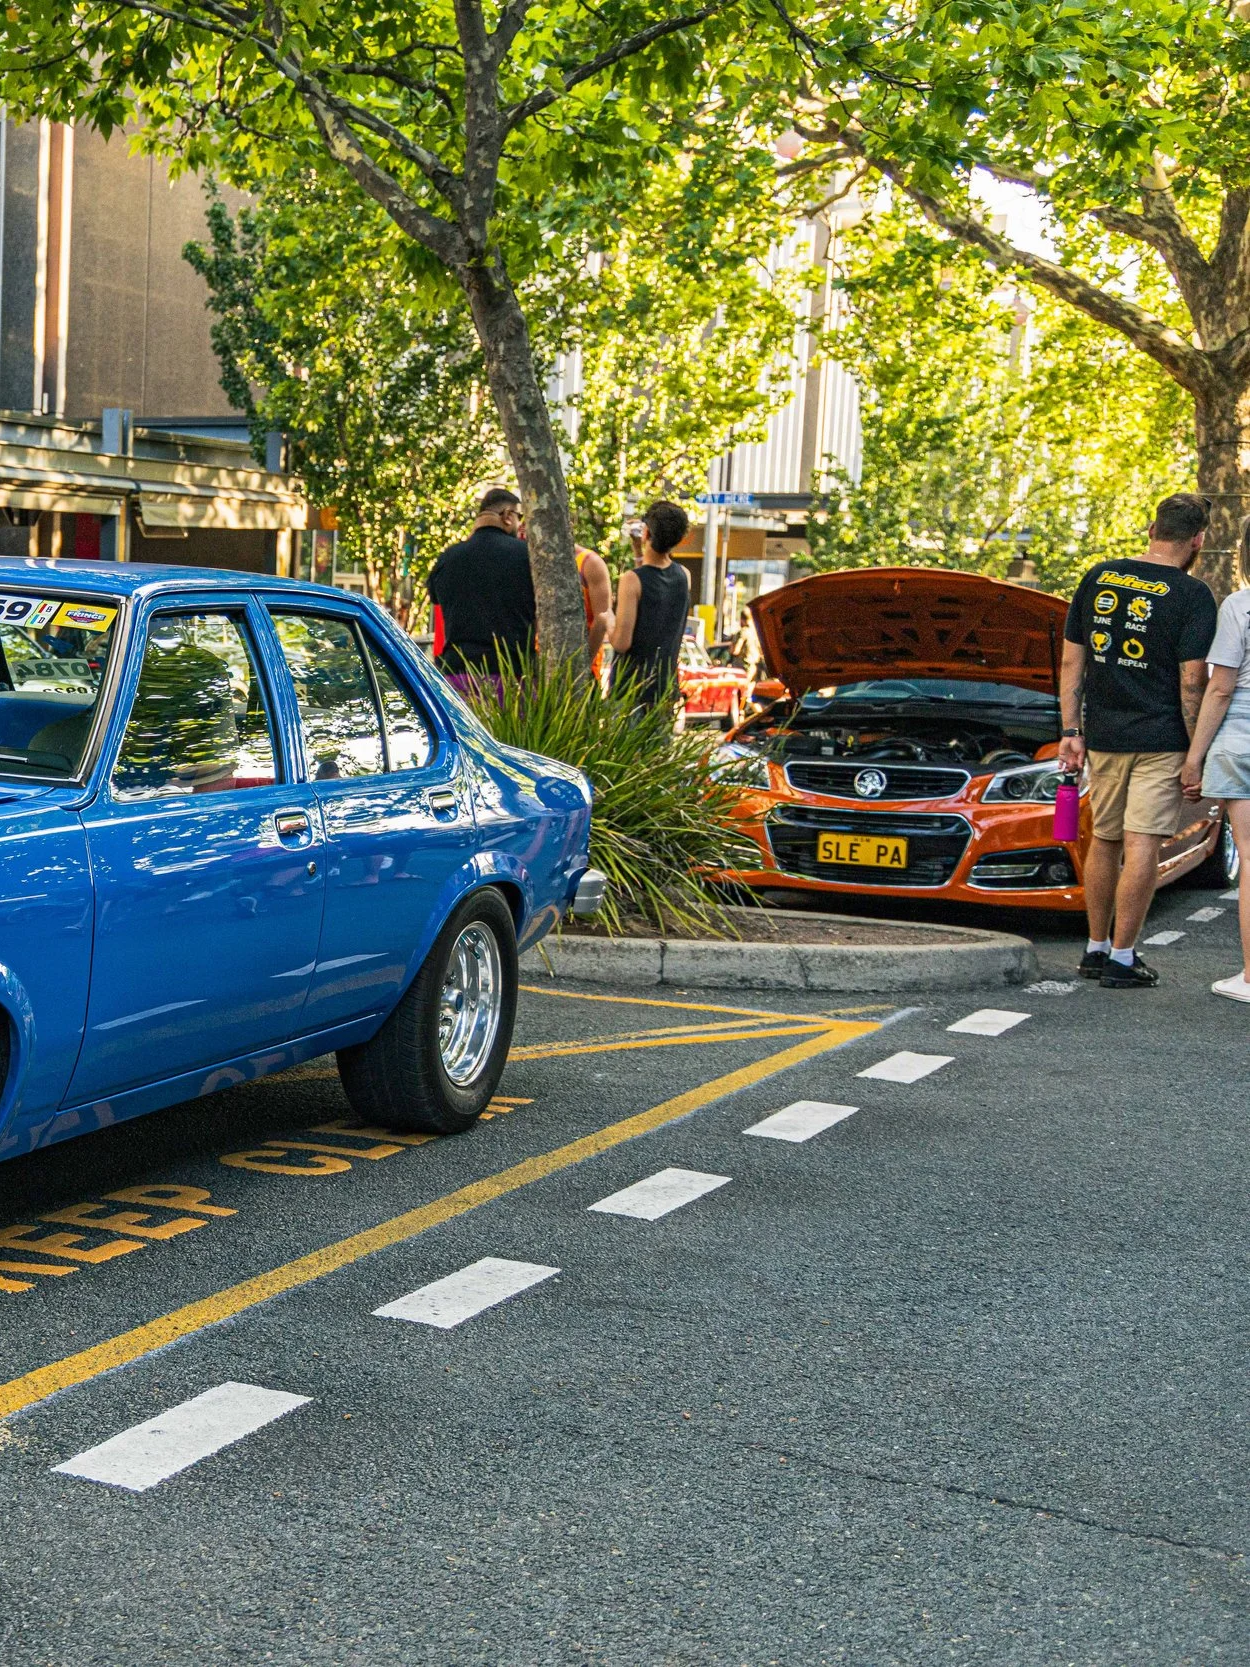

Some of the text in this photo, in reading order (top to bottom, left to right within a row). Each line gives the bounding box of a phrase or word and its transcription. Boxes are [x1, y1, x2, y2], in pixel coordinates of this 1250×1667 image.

[1097, 571, 1170, 596] Haltech
[66, 609, 107, 621] FRINGE
[1093, 616, 1112, 626] TUNE
[1124, 621, 1147, 633] RACE
[1117, 657, 1149, 669] REPEAT
[822, 841, 902, 865] SLE PA
